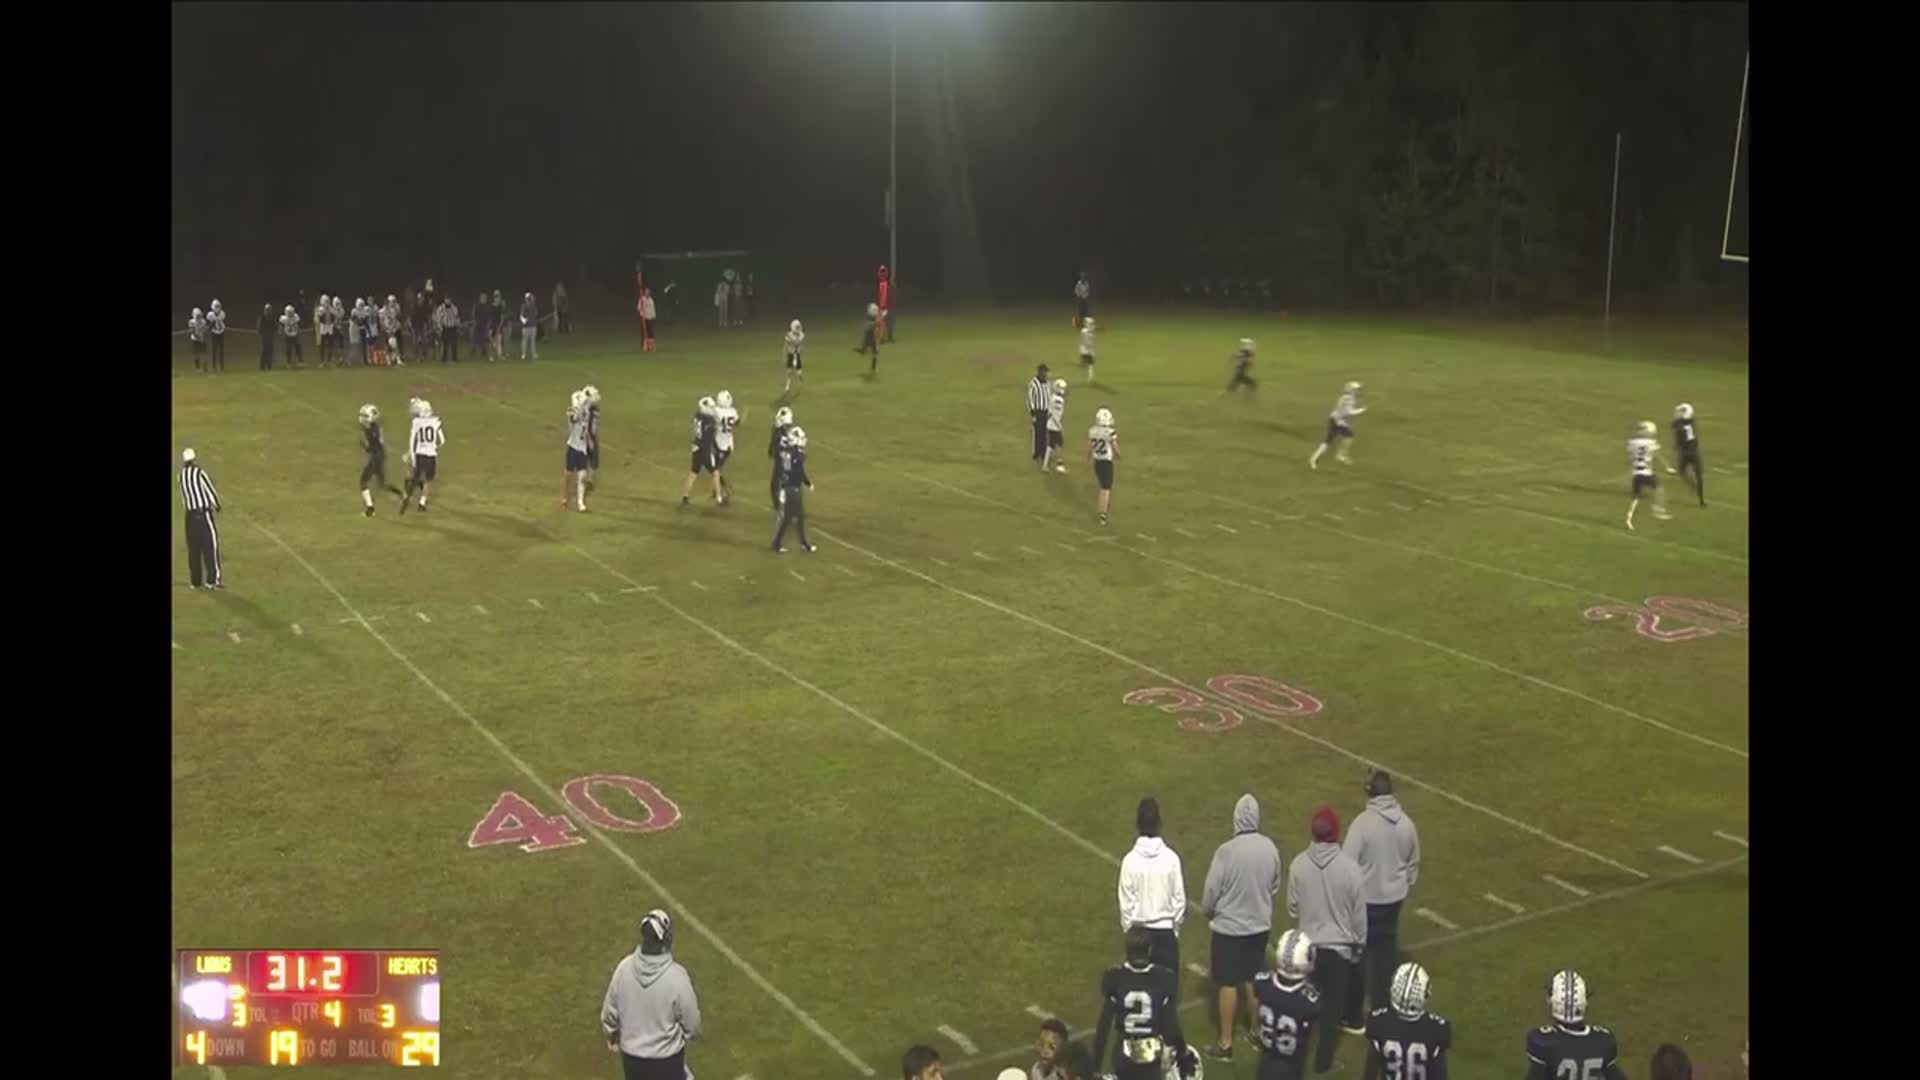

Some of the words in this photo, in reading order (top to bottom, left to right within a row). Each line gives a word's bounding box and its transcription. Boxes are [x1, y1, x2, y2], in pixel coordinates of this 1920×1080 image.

[419, 425, 435, 443] 10
[1583, 595, 1745, 642] 20
[1123, 674, 1323, 732] 30
[468, 774, 682, 852] 40
[1124, 991, 1153, 1034] 2
[1383, 1040, 1428, 1080] 36
